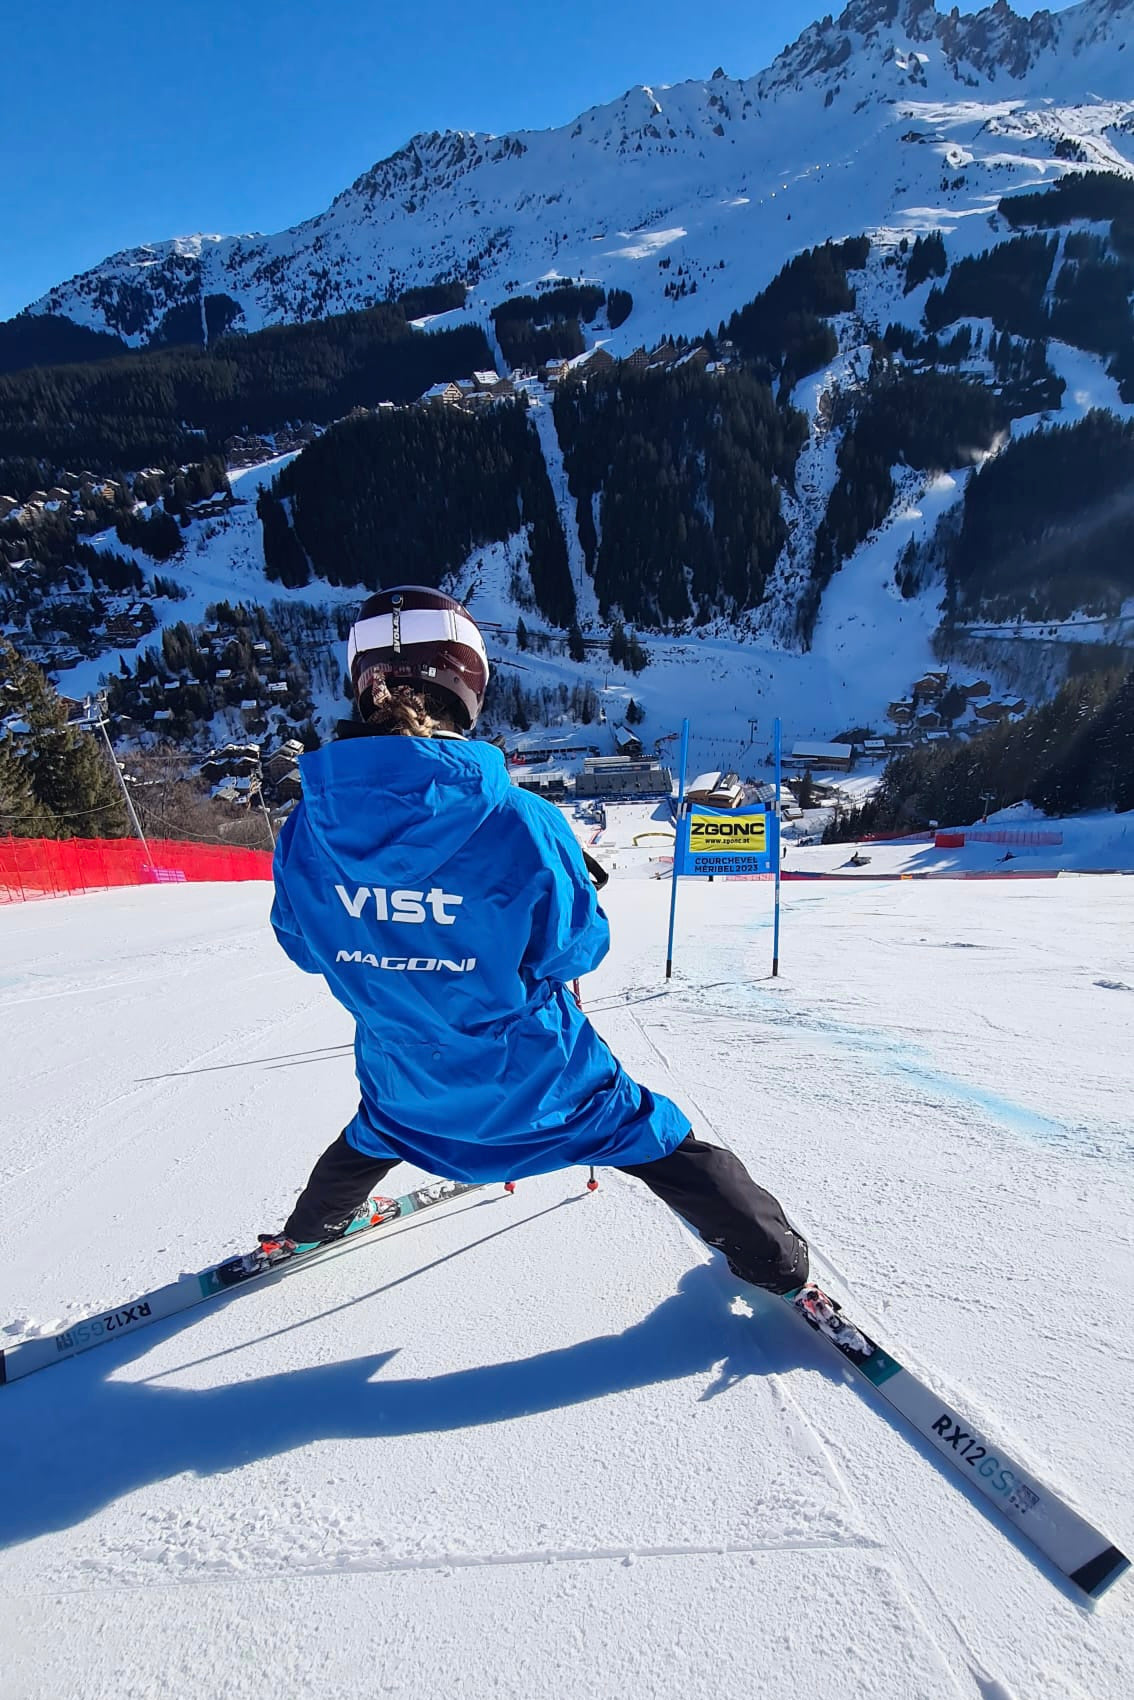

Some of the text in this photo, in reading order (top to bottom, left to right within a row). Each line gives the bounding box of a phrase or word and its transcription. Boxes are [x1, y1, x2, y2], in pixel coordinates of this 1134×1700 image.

[691, 823, 765, 835] ZGONC
[695, 857, 758, 865] COURCHEVEL
[336, 950, 476, 972] MAGONI
